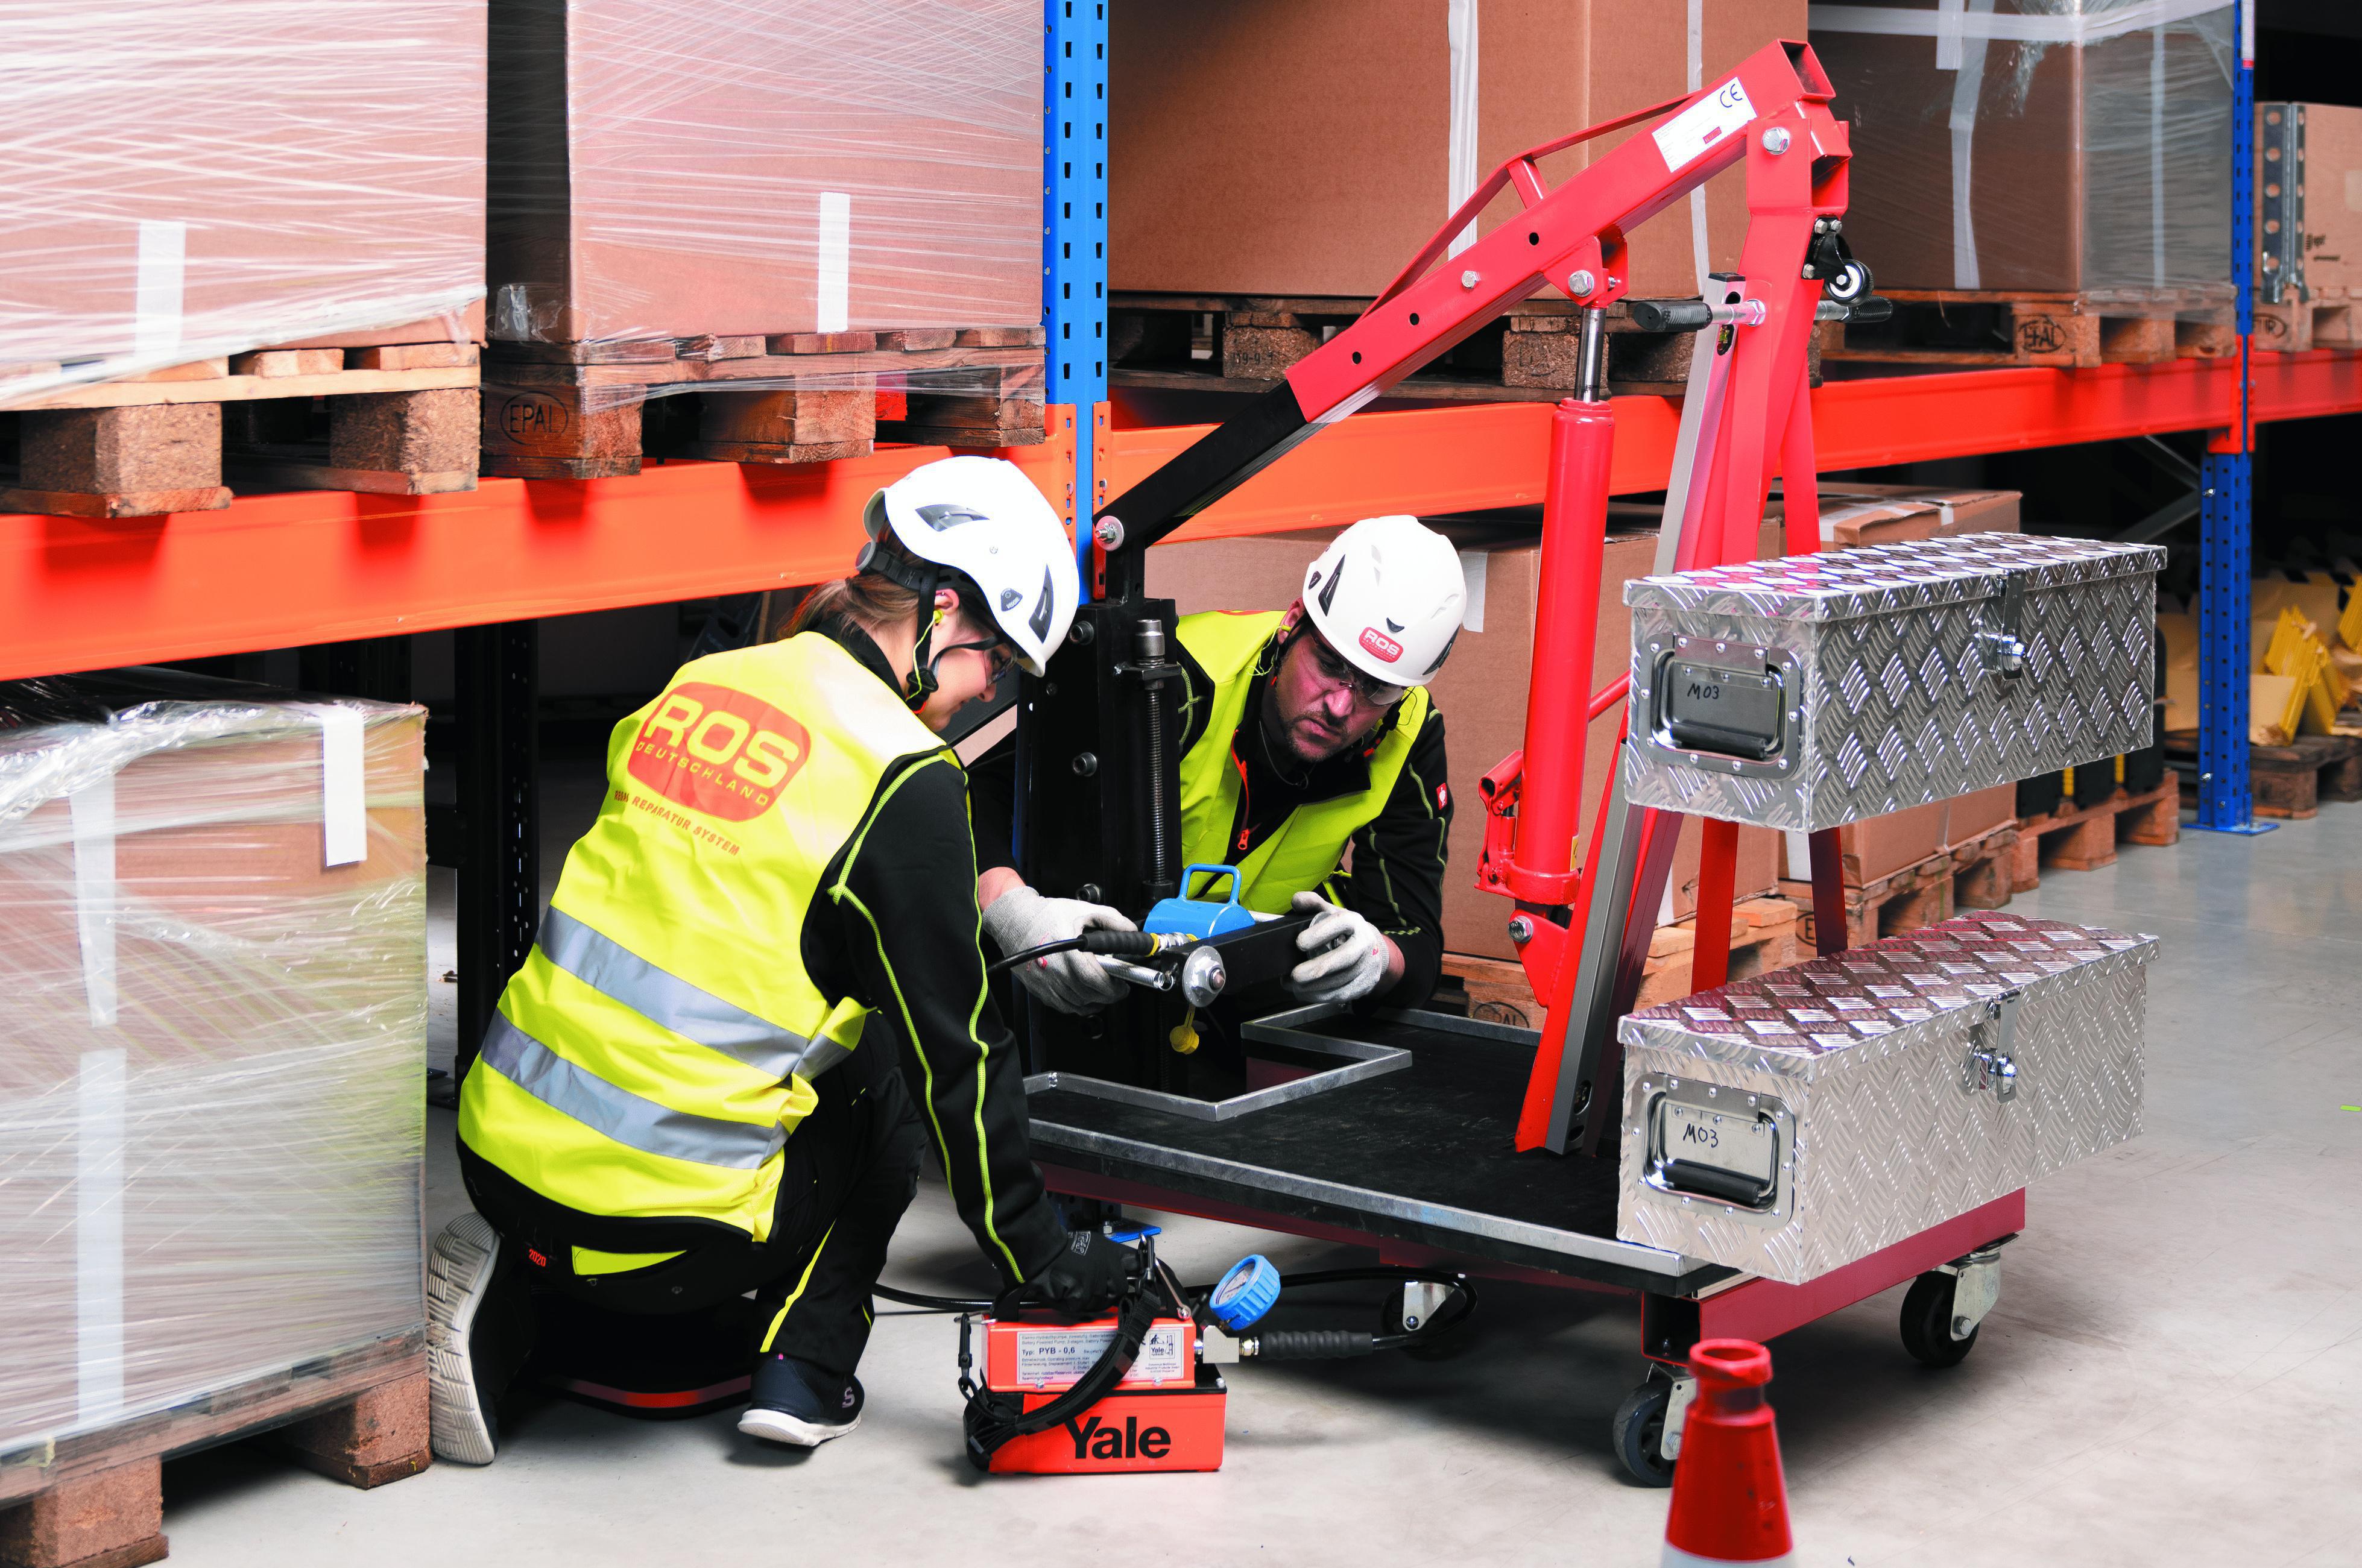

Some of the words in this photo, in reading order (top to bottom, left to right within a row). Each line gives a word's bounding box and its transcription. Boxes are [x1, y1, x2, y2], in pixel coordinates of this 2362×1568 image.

[1720, 83, 1743, 108] CE
[509, 404, 559, 433] EPAL
[1364, 629, 1400, 656] ROS
[643, 693, 800, 789] ROS
[635, 741, 770, 807] DEUTSCHLAND
[631, 796, 692, 830] REPARATUR
[693, 825, 740, 856] SYSTEM
[528, 1248, 547, 1267] 2020
[1063, 1346, 1075, 1355] 0,6
[842, 1386, 855, 1408] S
[1065, 1415, 1171, 1459] Yale
